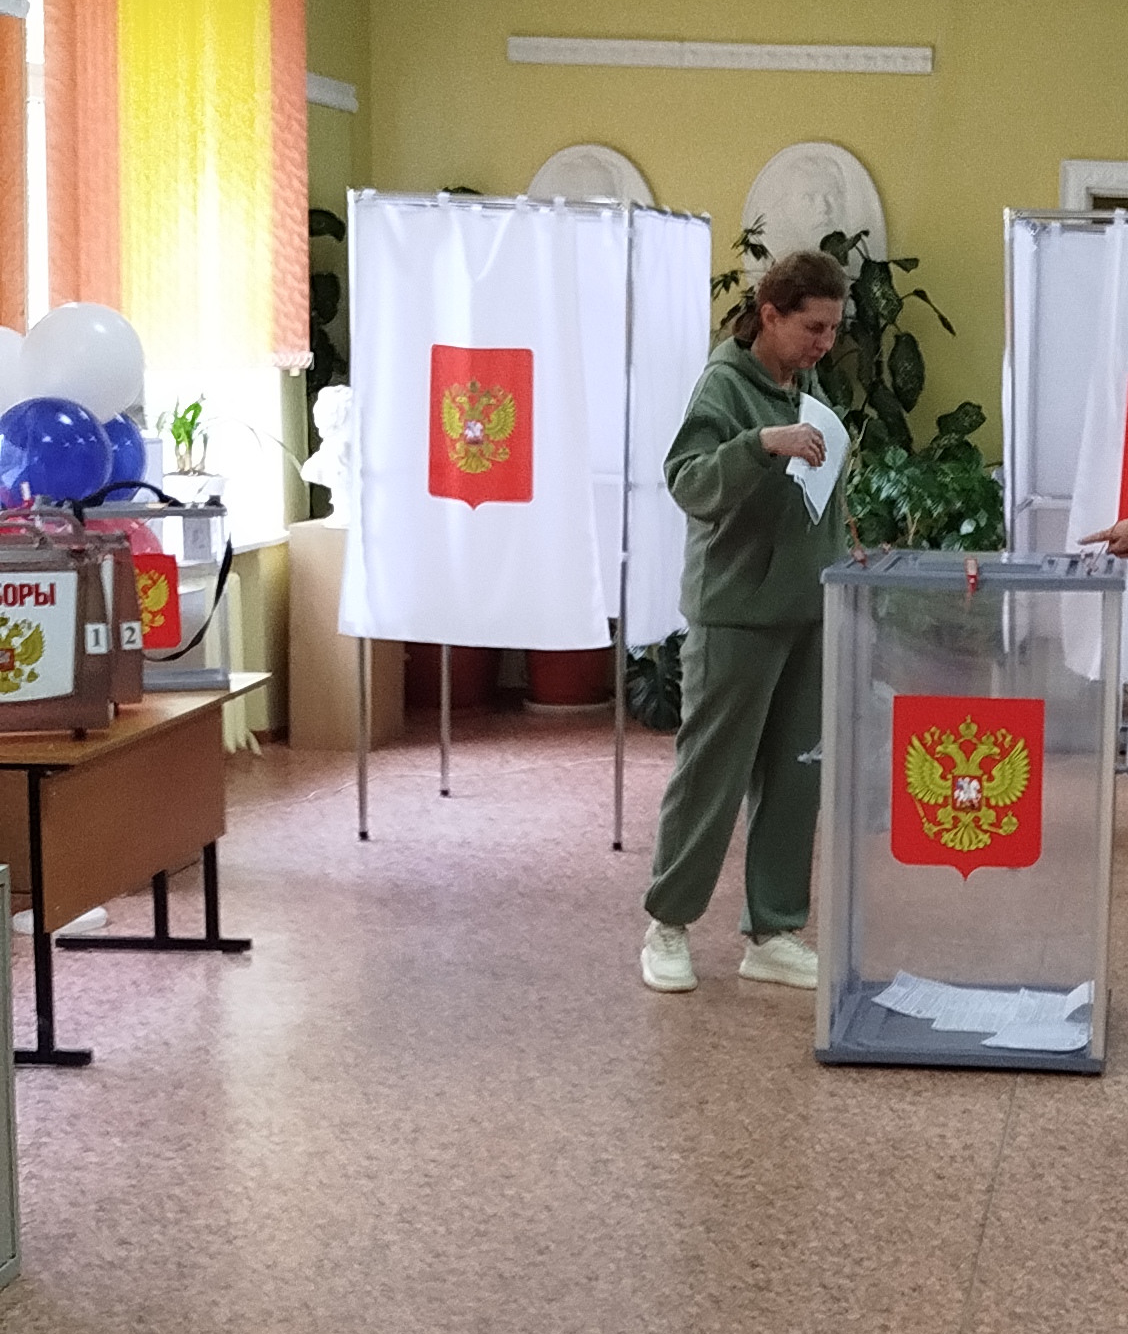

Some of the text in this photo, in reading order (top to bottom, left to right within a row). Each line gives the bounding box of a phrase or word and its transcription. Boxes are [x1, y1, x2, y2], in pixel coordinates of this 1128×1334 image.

[0, 582, 55, 607] ОРЫ
[93, 628, 101, 647] 1
[124, 626, 137, 645] 2
